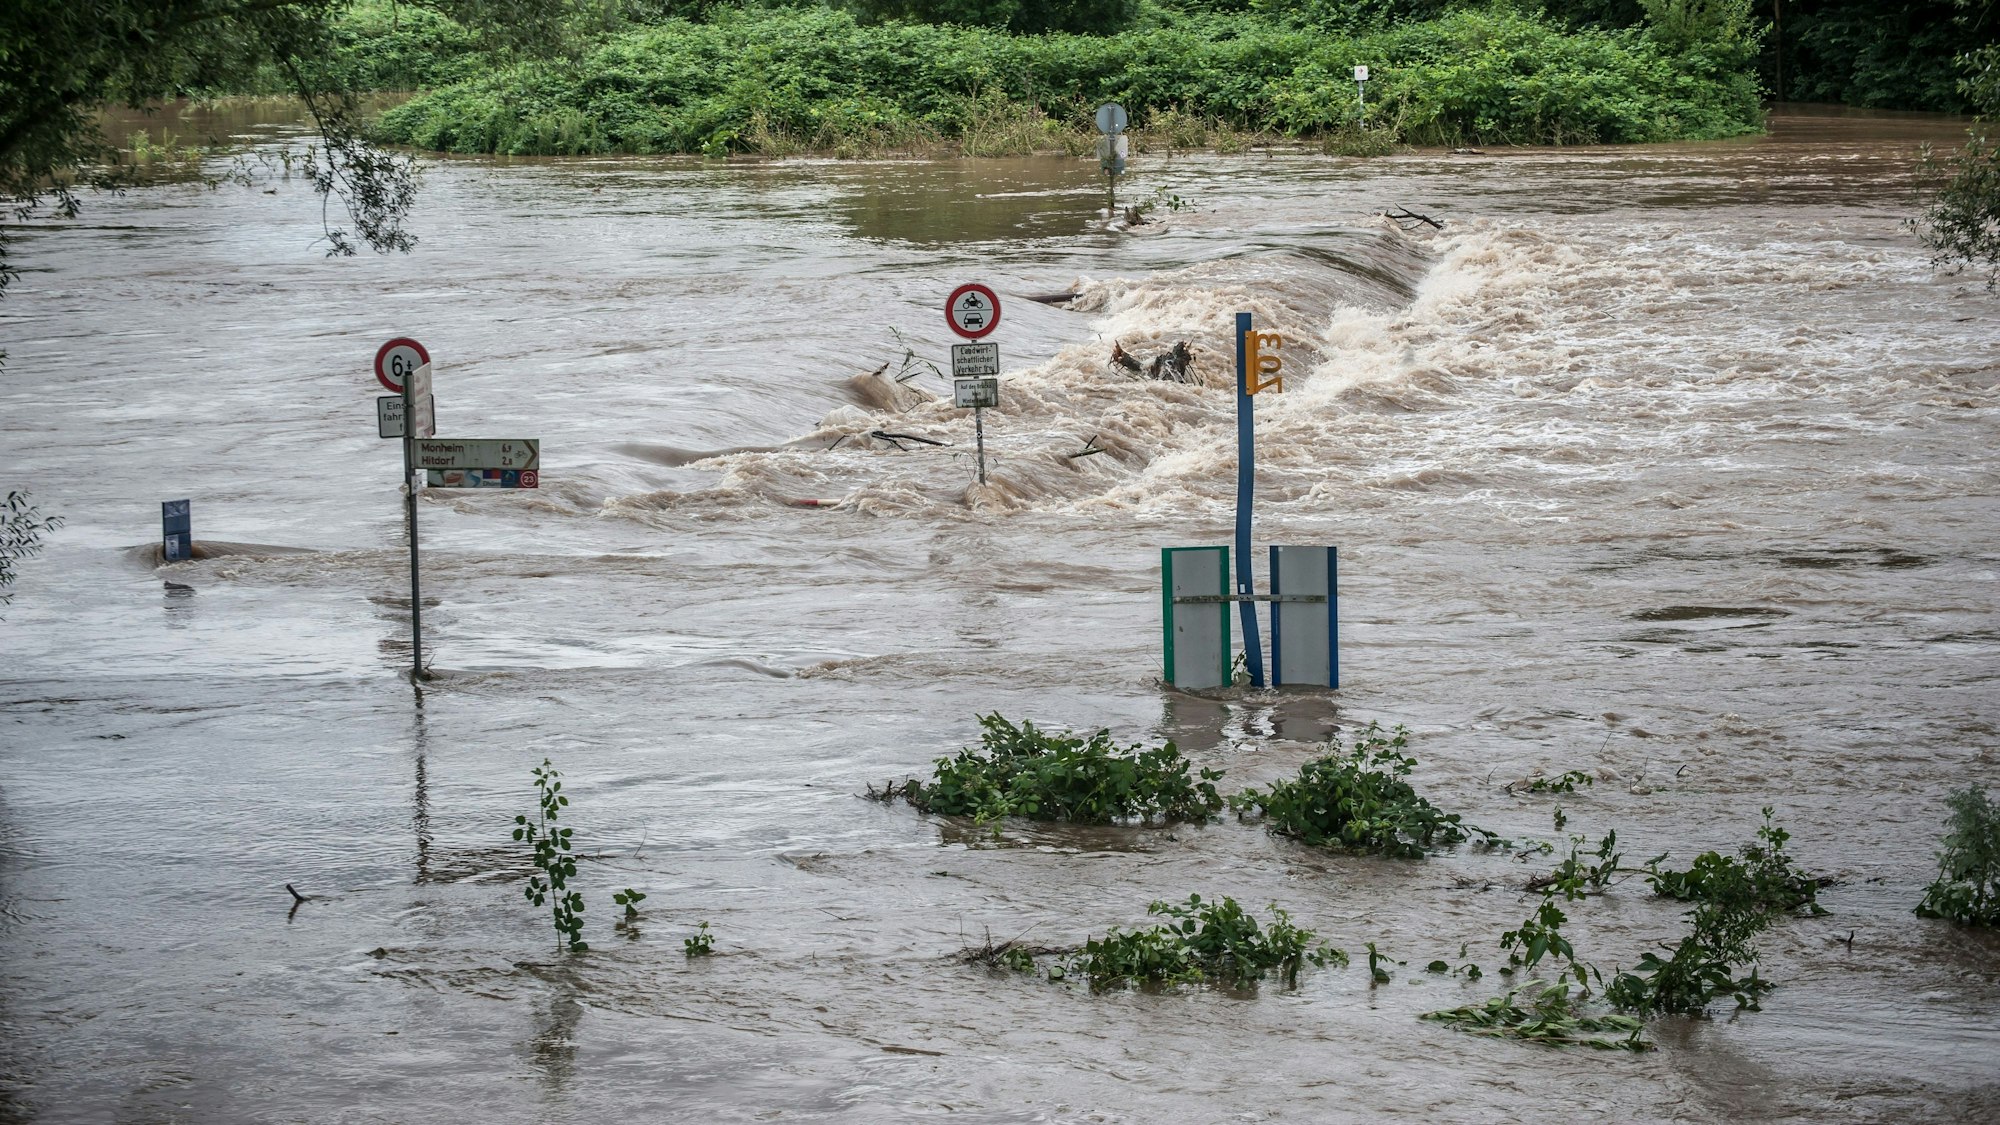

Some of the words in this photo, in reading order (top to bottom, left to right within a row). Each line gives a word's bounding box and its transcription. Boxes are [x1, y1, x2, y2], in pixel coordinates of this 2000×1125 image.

[957, 364, 982, 373] Verkehr
[386, 402, 406, 410] Eins
[383, 413, 404, 422] fahr
[421, 443, 464, 452] Monheim
[421, 455, 455, 465] Hitdorf
[523, 475, 534, 483] 23
